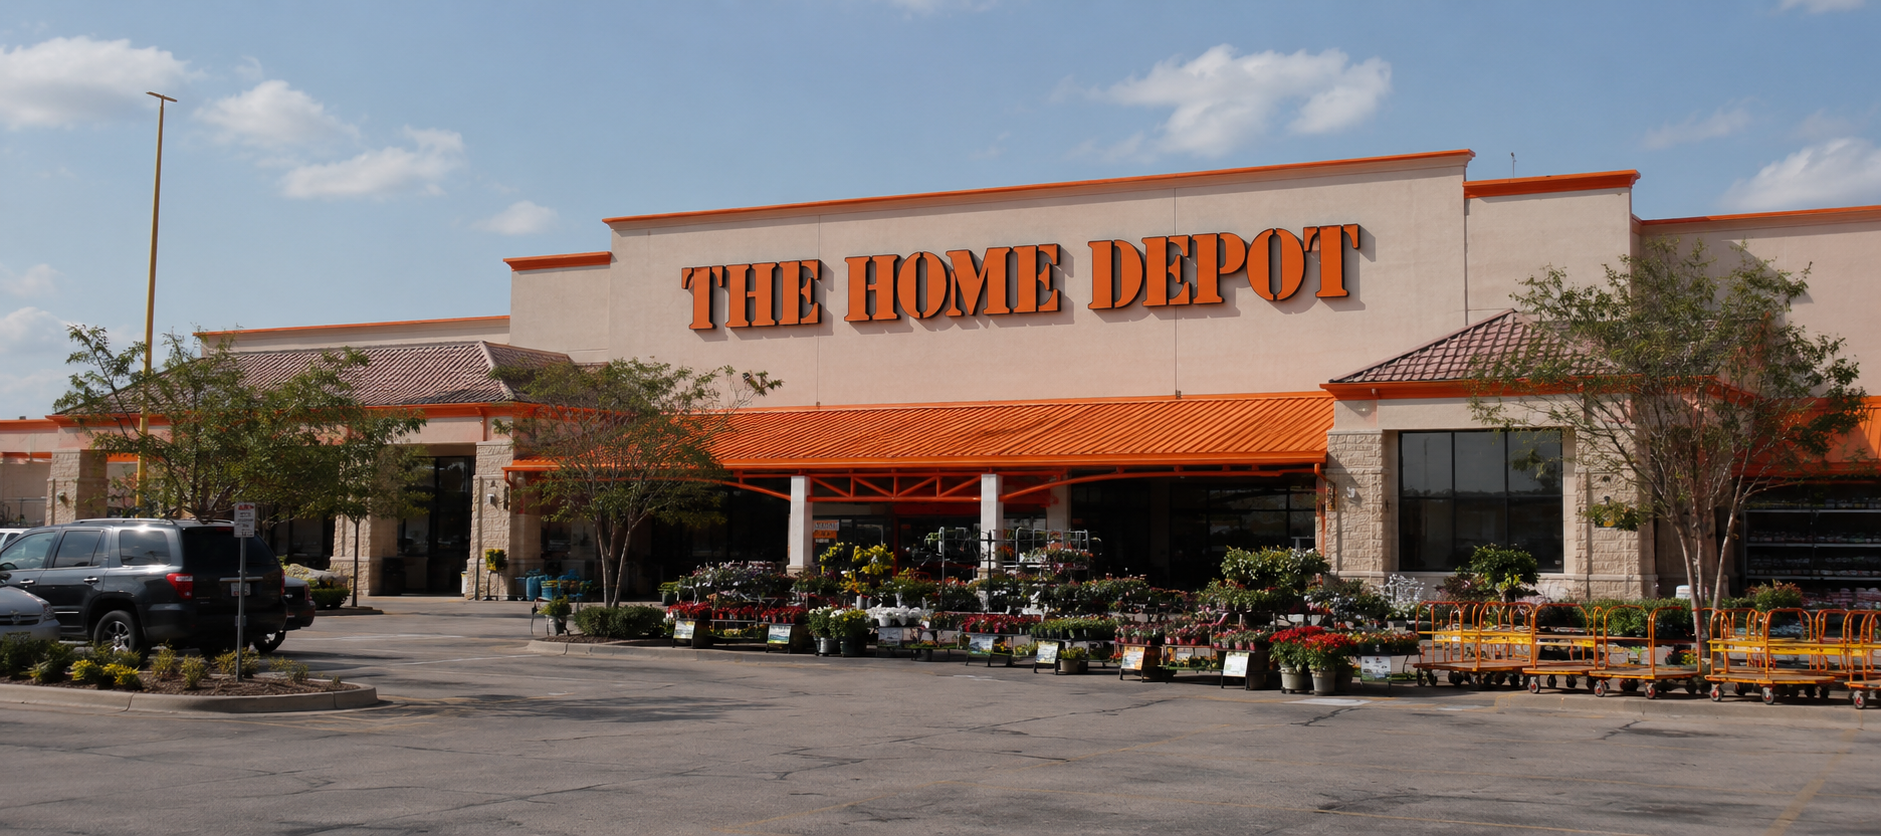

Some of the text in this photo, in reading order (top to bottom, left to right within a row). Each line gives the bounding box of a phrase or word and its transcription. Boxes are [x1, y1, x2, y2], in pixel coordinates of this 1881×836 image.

[681, 223, 1361, 329] THE HOME DEPOT
